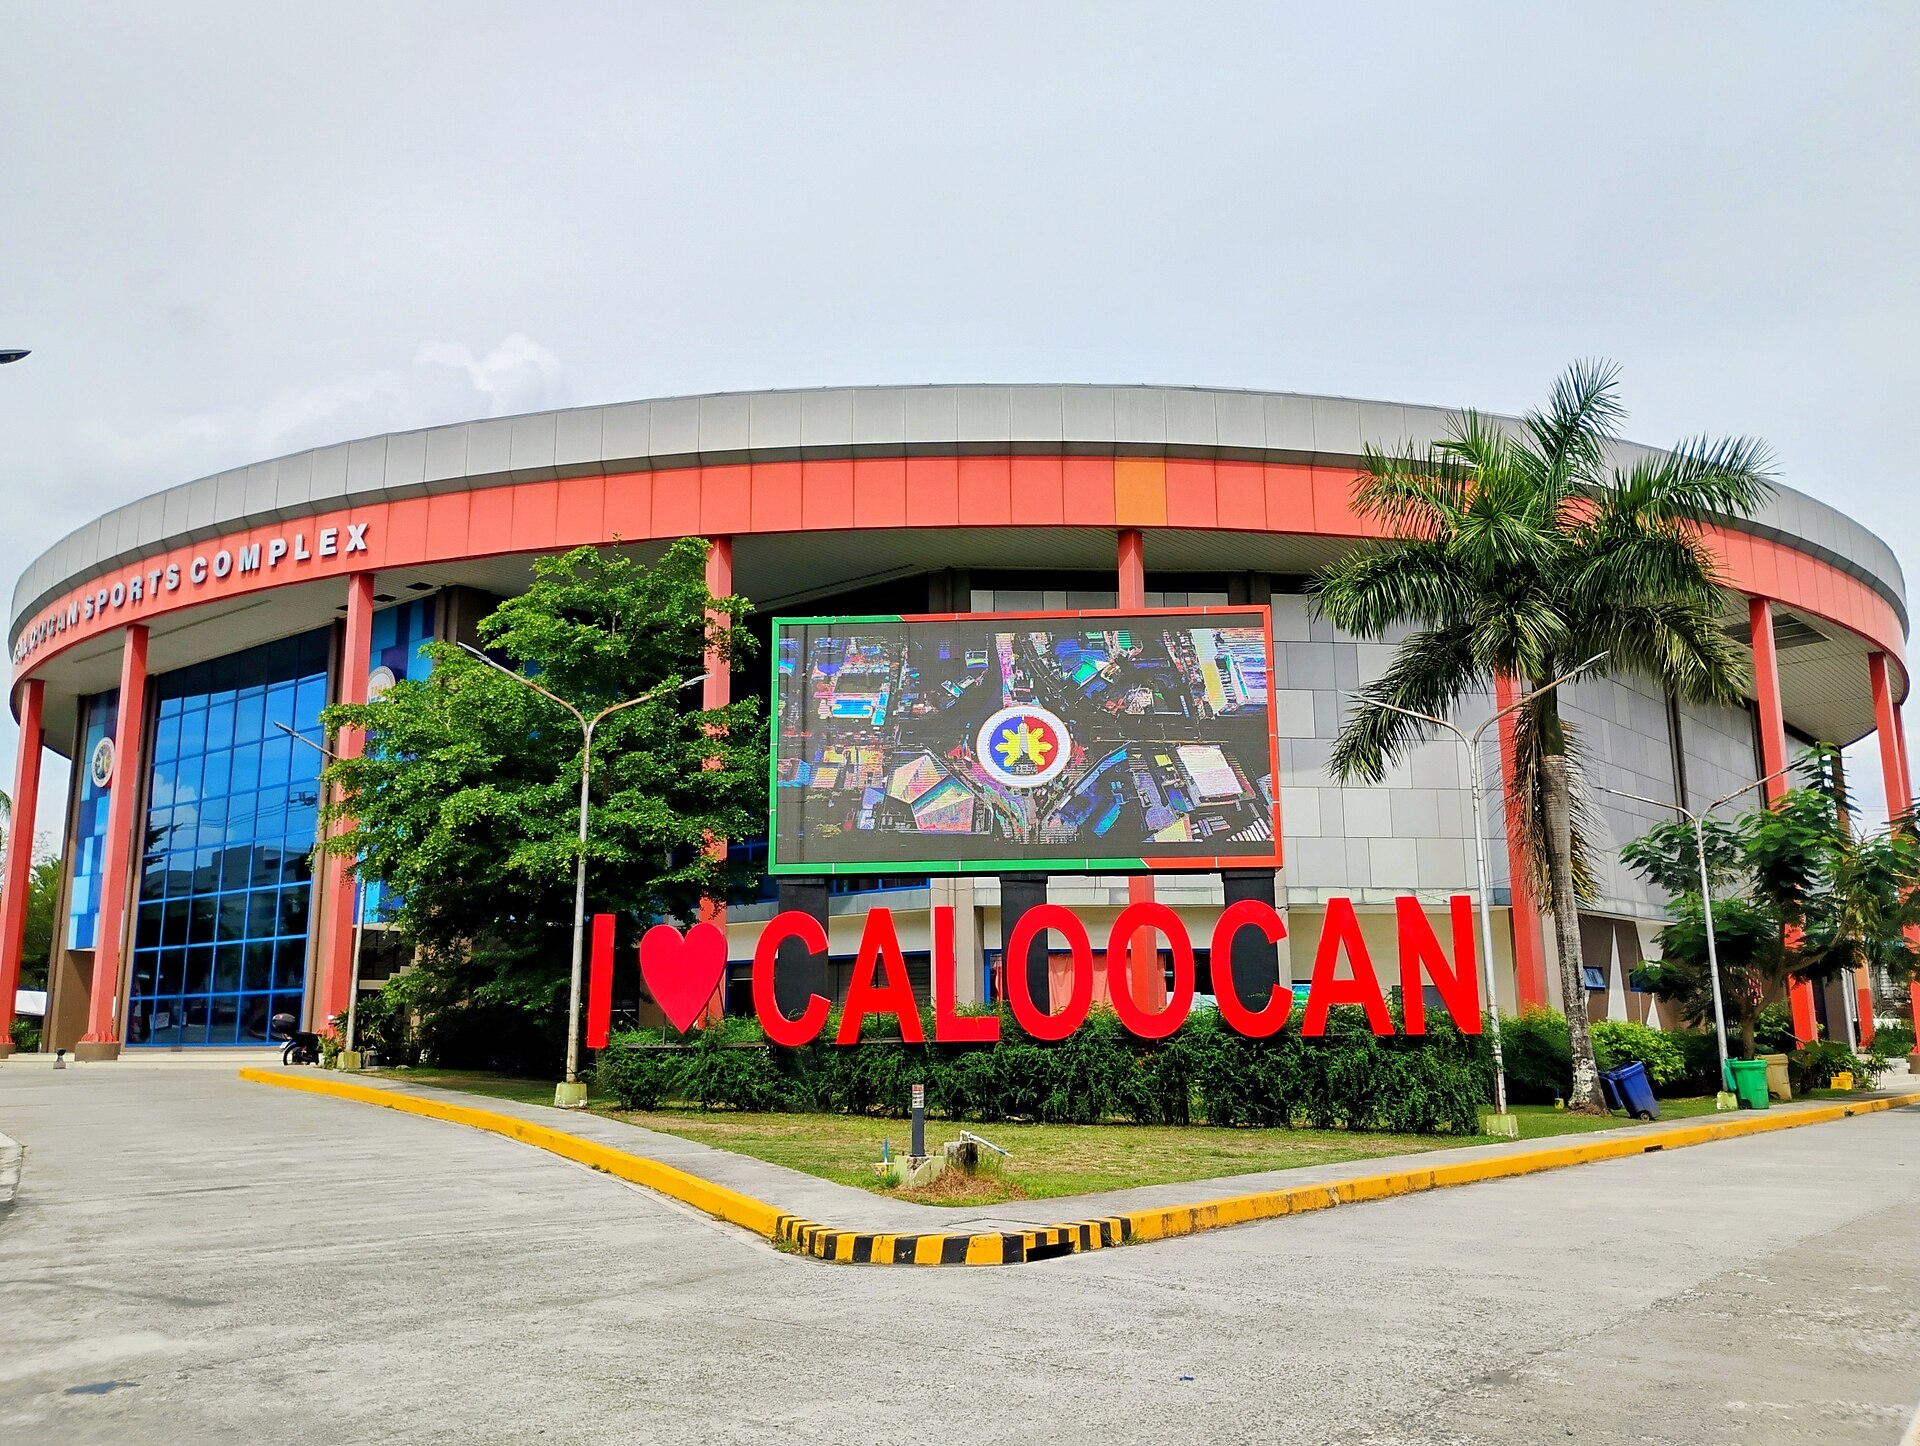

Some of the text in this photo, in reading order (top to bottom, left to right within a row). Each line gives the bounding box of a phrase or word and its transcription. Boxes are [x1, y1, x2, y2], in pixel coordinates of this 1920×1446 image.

[83, 563, 181, 621] SPORTS
[190, 522, 369, 585] COMPLEX
[586, 894, 1483, 1049] I CALOOCAN
